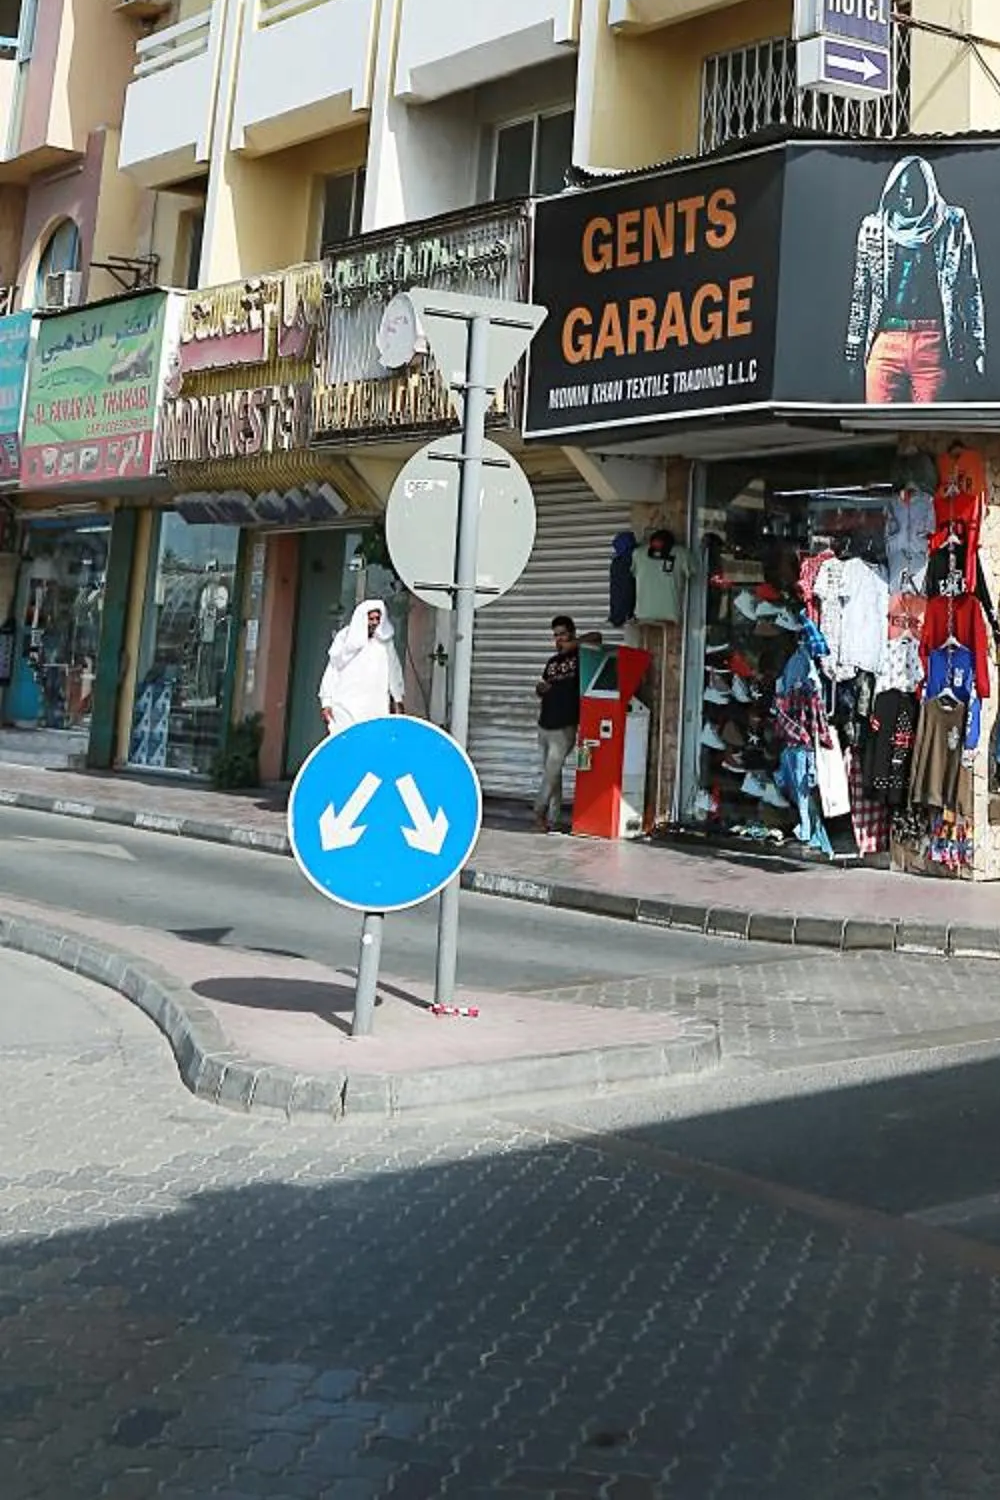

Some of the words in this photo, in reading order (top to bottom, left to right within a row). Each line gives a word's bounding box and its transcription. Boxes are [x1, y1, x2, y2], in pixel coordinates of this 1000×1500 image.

[582, 188, 737, 274] GENTS
[561, 276, 755, 365] GARAGE
[548, 385, 590, 409] MOMIN
[591, 379, 623, 404] KHAN
[626, 373, 669, 399] TEXTILE
[673, 364, 725, 393] TRADING
